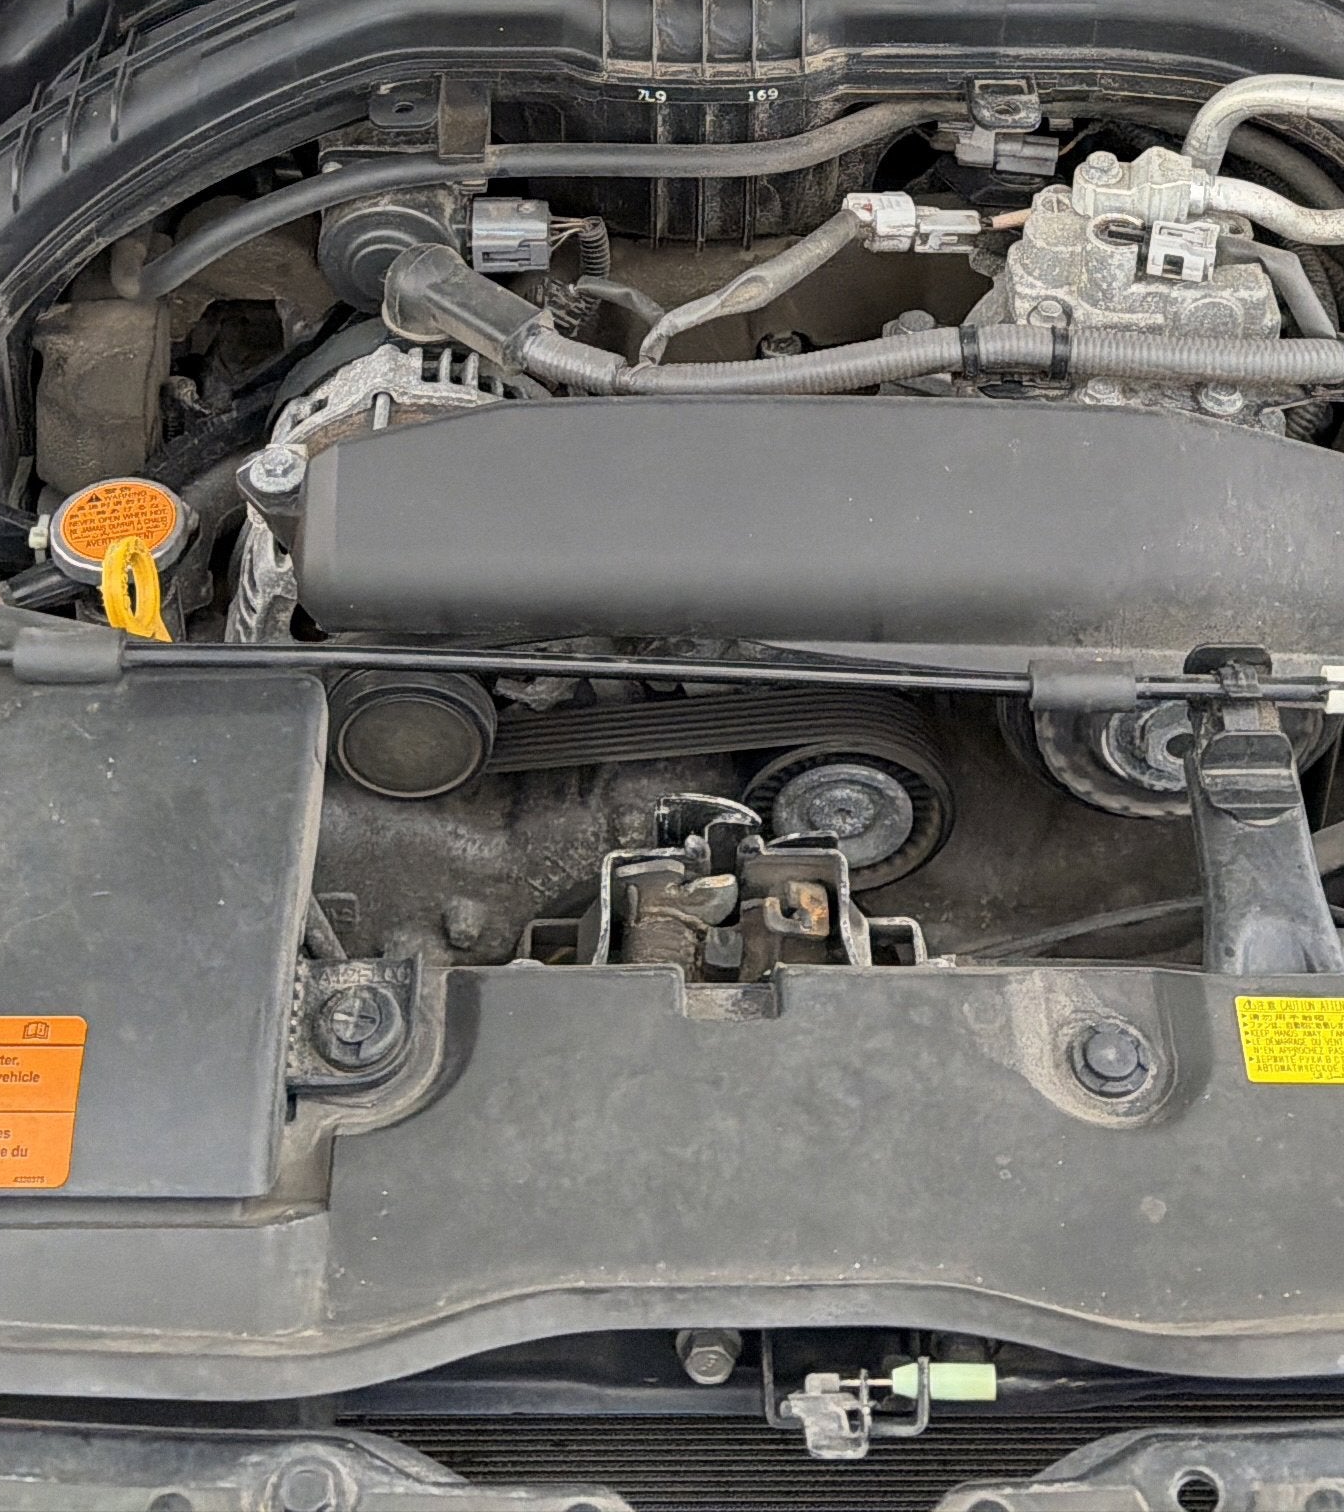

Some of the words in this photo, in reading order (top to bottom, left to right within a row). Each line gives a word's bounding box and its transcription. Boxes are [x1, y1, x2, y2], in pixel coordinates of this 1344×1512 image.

[748, 88, 779, 102] 169
[1280, 1000, 1316, 1011] CAUTION
[1328, 1047, 1344, 1055] PAS
[11, 1144, 29, 1157] du
